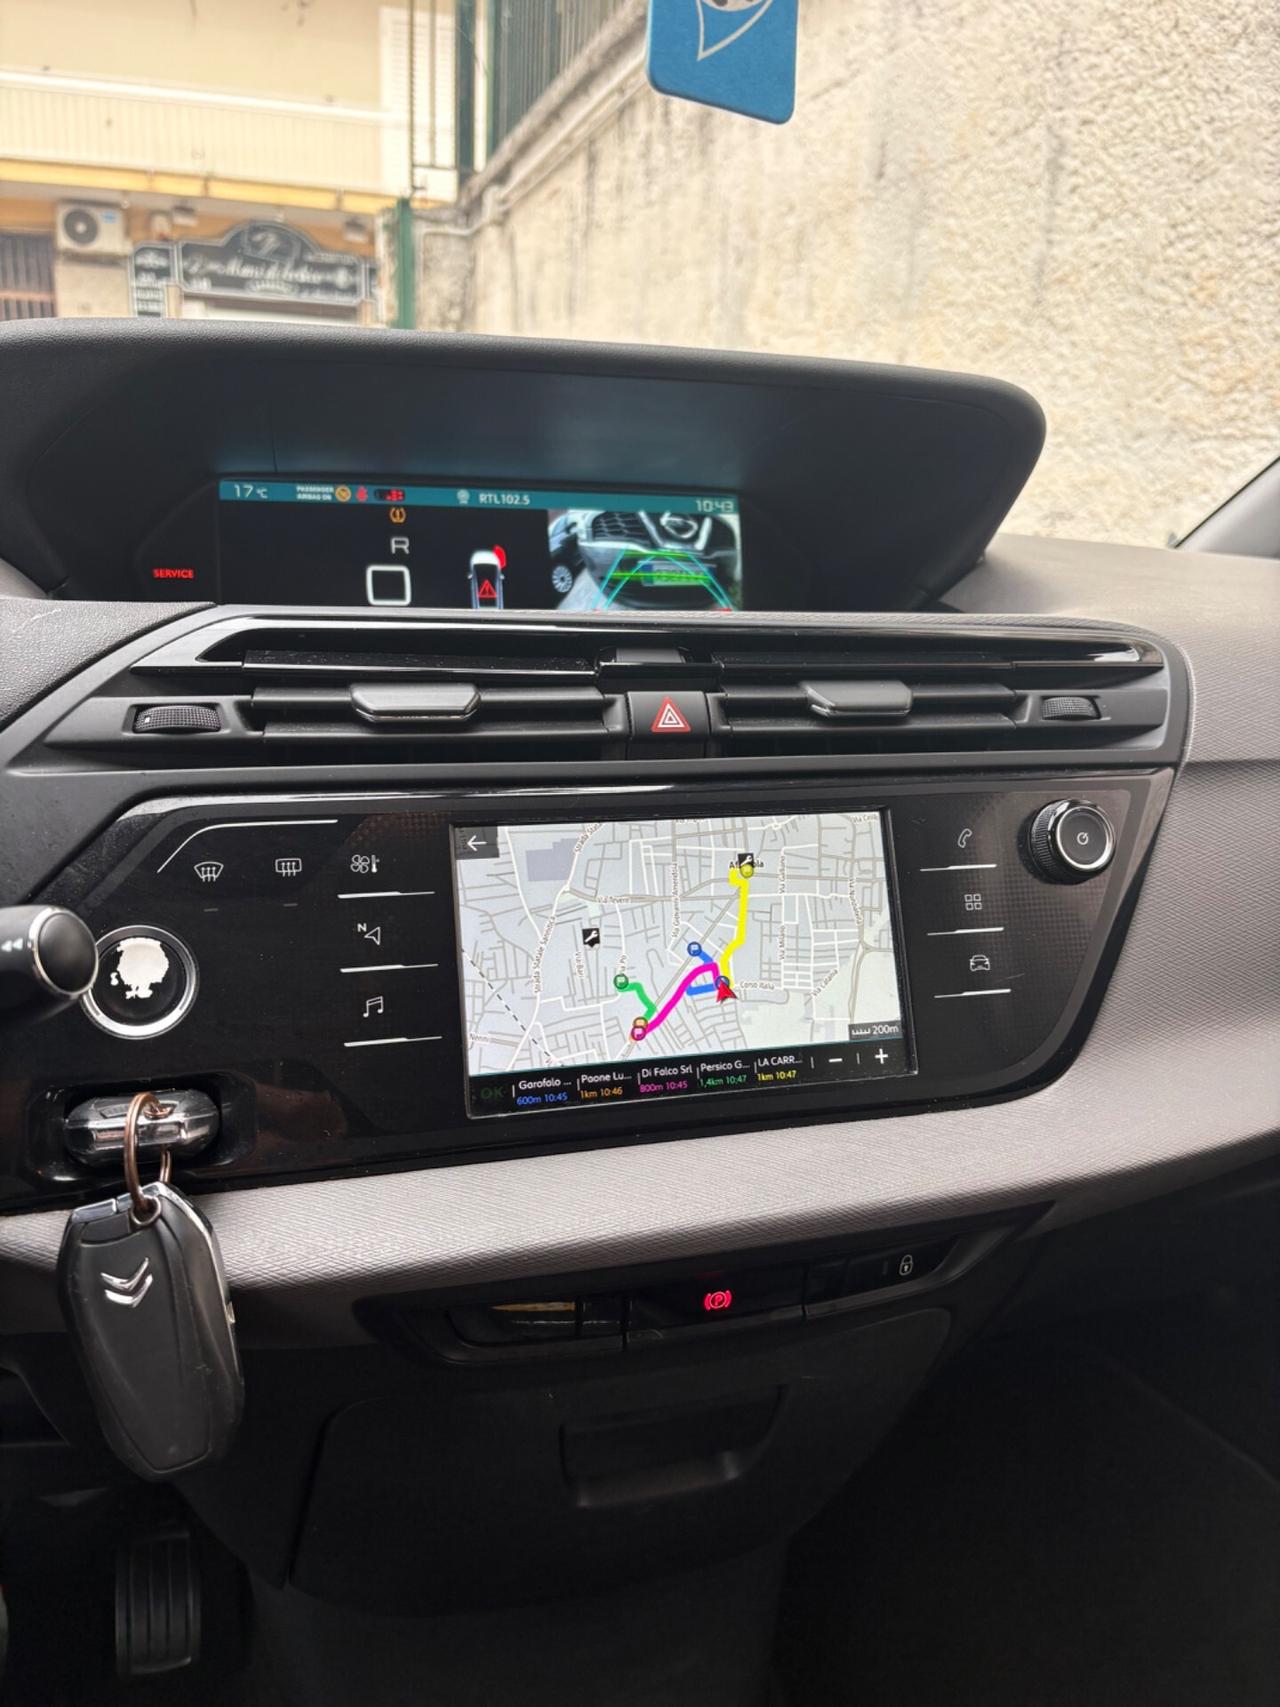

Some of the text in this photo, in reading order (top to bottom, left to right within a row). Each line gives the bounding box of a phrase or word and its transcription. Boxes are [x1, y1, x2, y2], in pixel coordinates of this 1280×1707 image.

[233, 483, 254, 498] 17
[696, 498, 734, 513] 10:43
[390, 537, 409, 554] R
[153, 568, 194, 579] SERVICE
[872, 1025, 899, 1035] 200m
[700, 1062, 733, 1072] Persico
[757, 1058, 769, 1067] LA
[641, 1063, 693, 1078] Di Falco Srl
[757, 1070, 797, 1081] 1km 10:47
[518, 1078, 561, 1090] Garofalo
[581, 1073, 611, 1084] Paone
[700, 1074, 747, 1088] 1,4km 10:47
[580, 1087, 623, 1098] 1km 10:46
[639, 1081, 688, 1093] 800m 10:45
[516, 1092, 568, 1105] 600m 10:45
